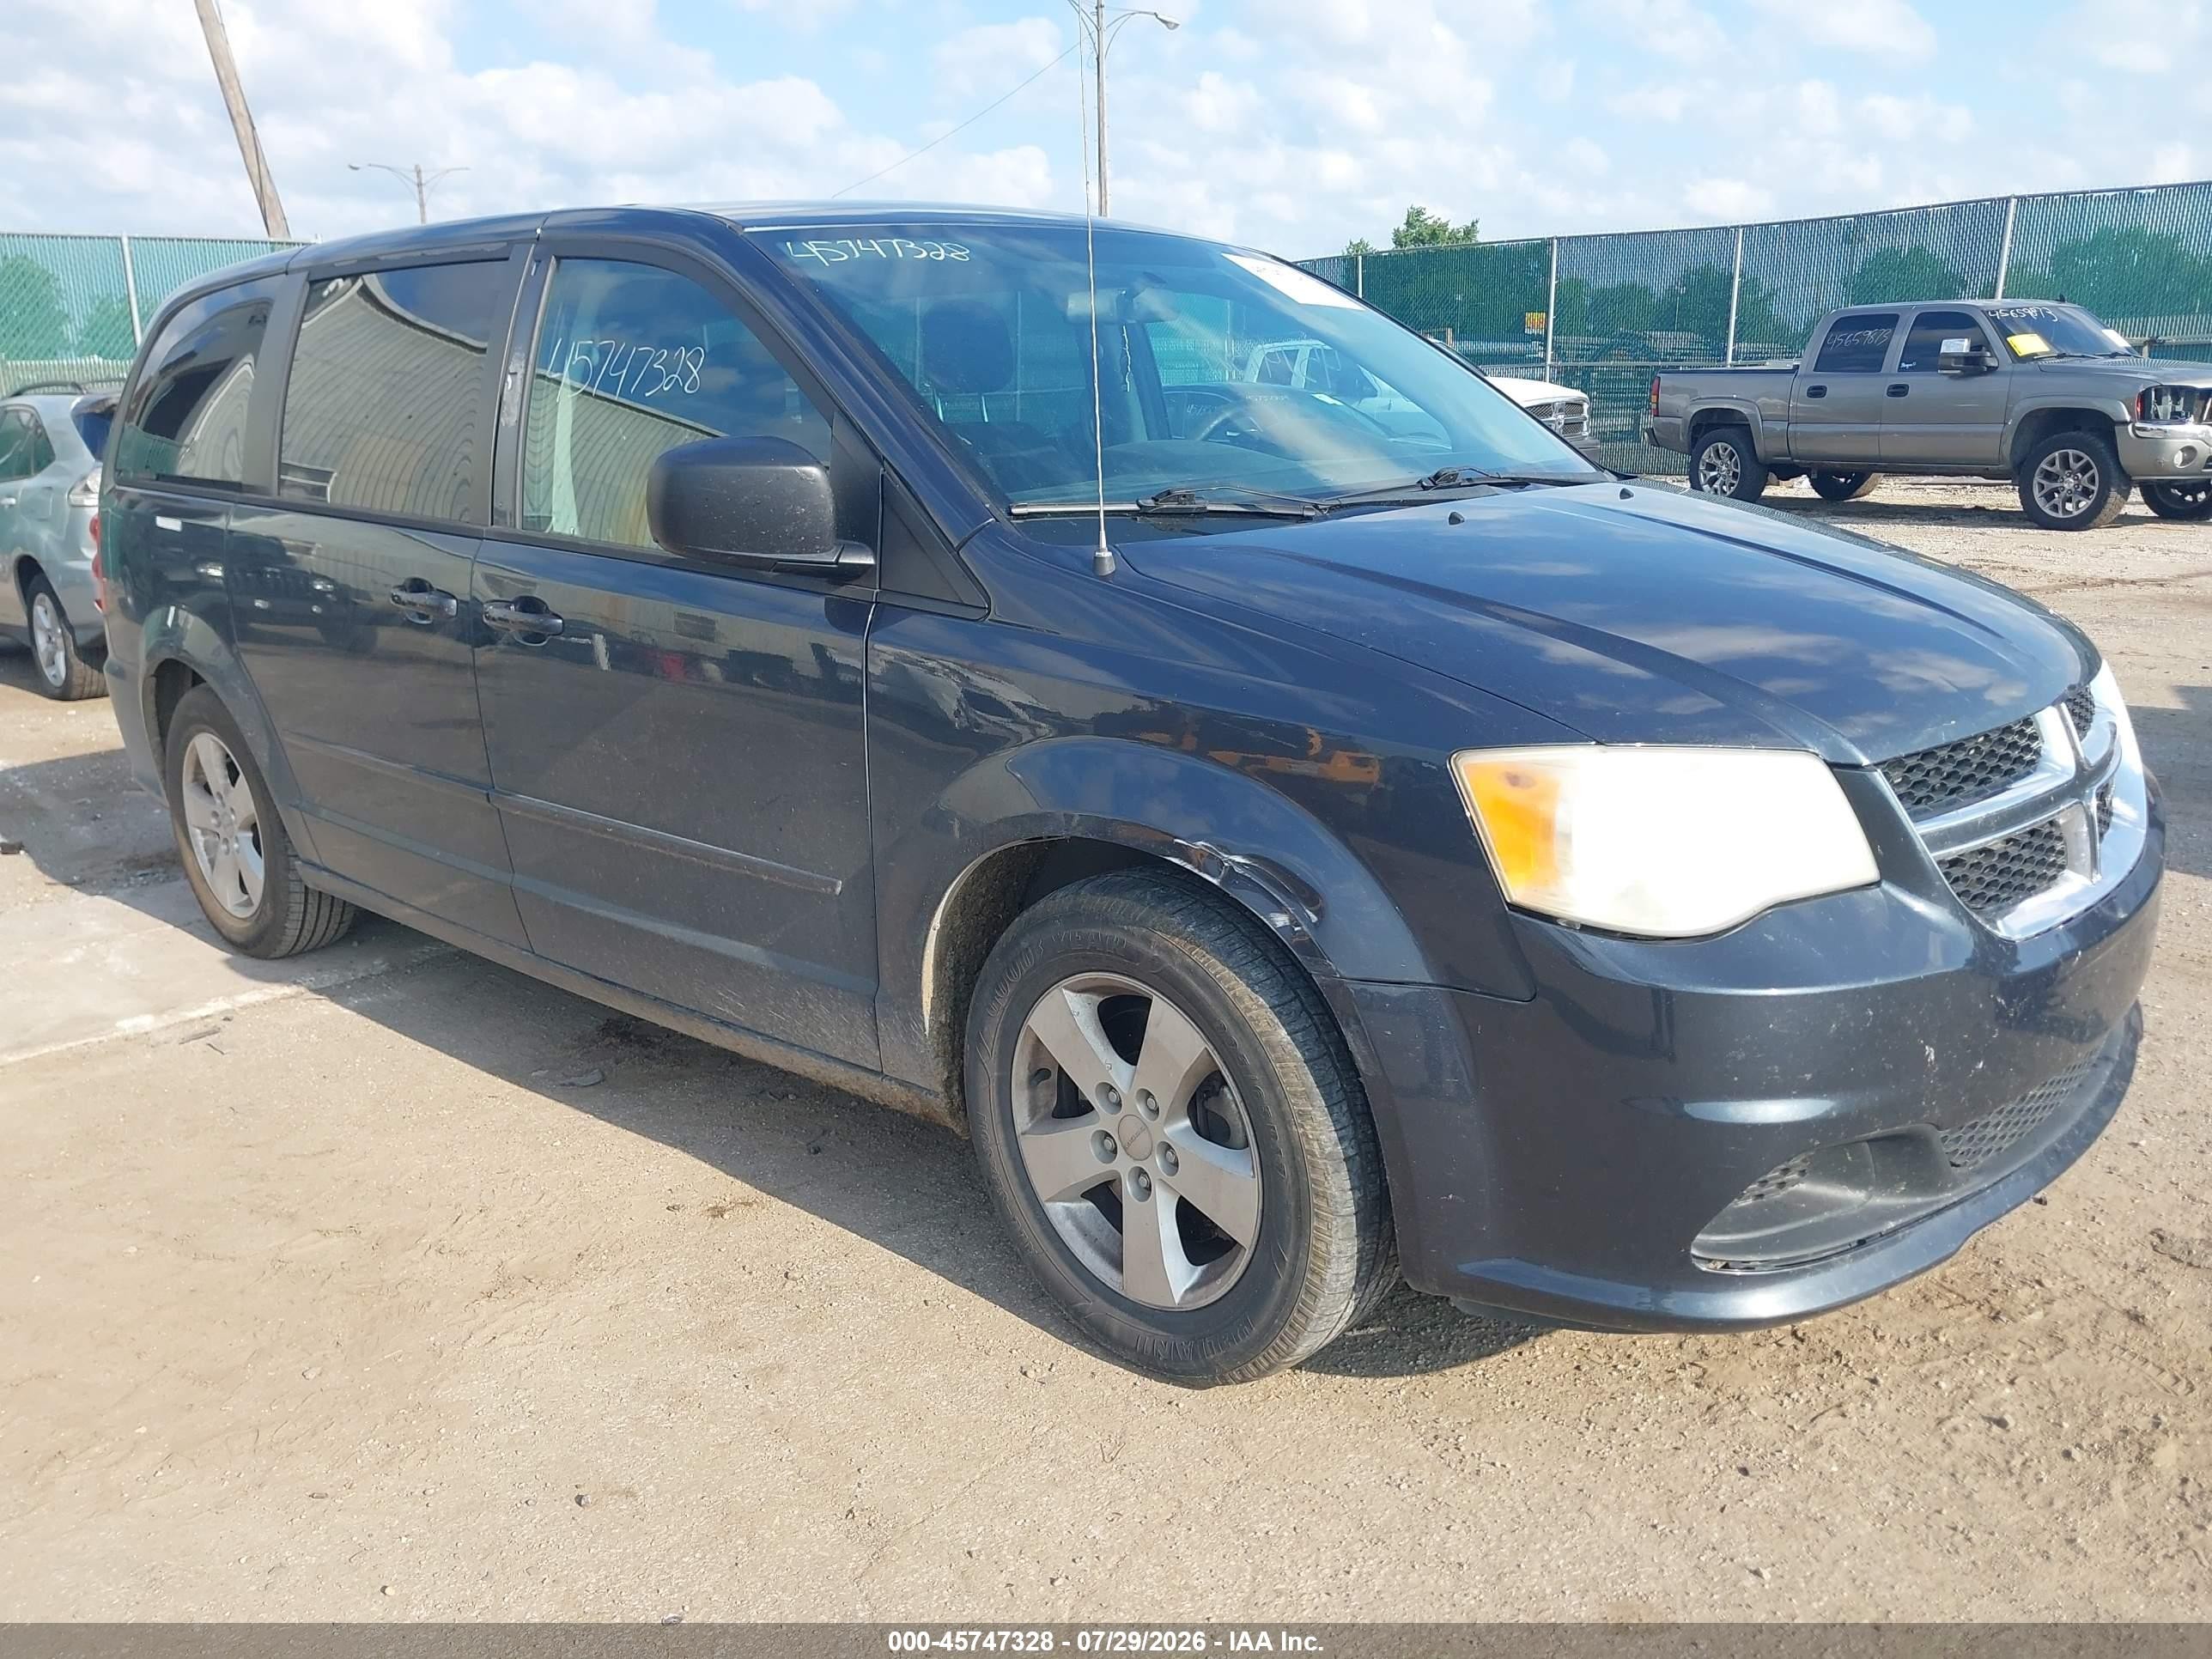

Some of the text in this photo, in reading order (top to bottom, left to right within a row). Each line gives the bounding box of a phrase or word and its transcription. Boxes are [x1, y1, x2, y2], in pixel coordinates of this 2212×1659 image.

[785, 239, 970, 267] 45747328
[1826, 328, 1892, 351] 45659873
[546, 337, 705, 404] 45747328
